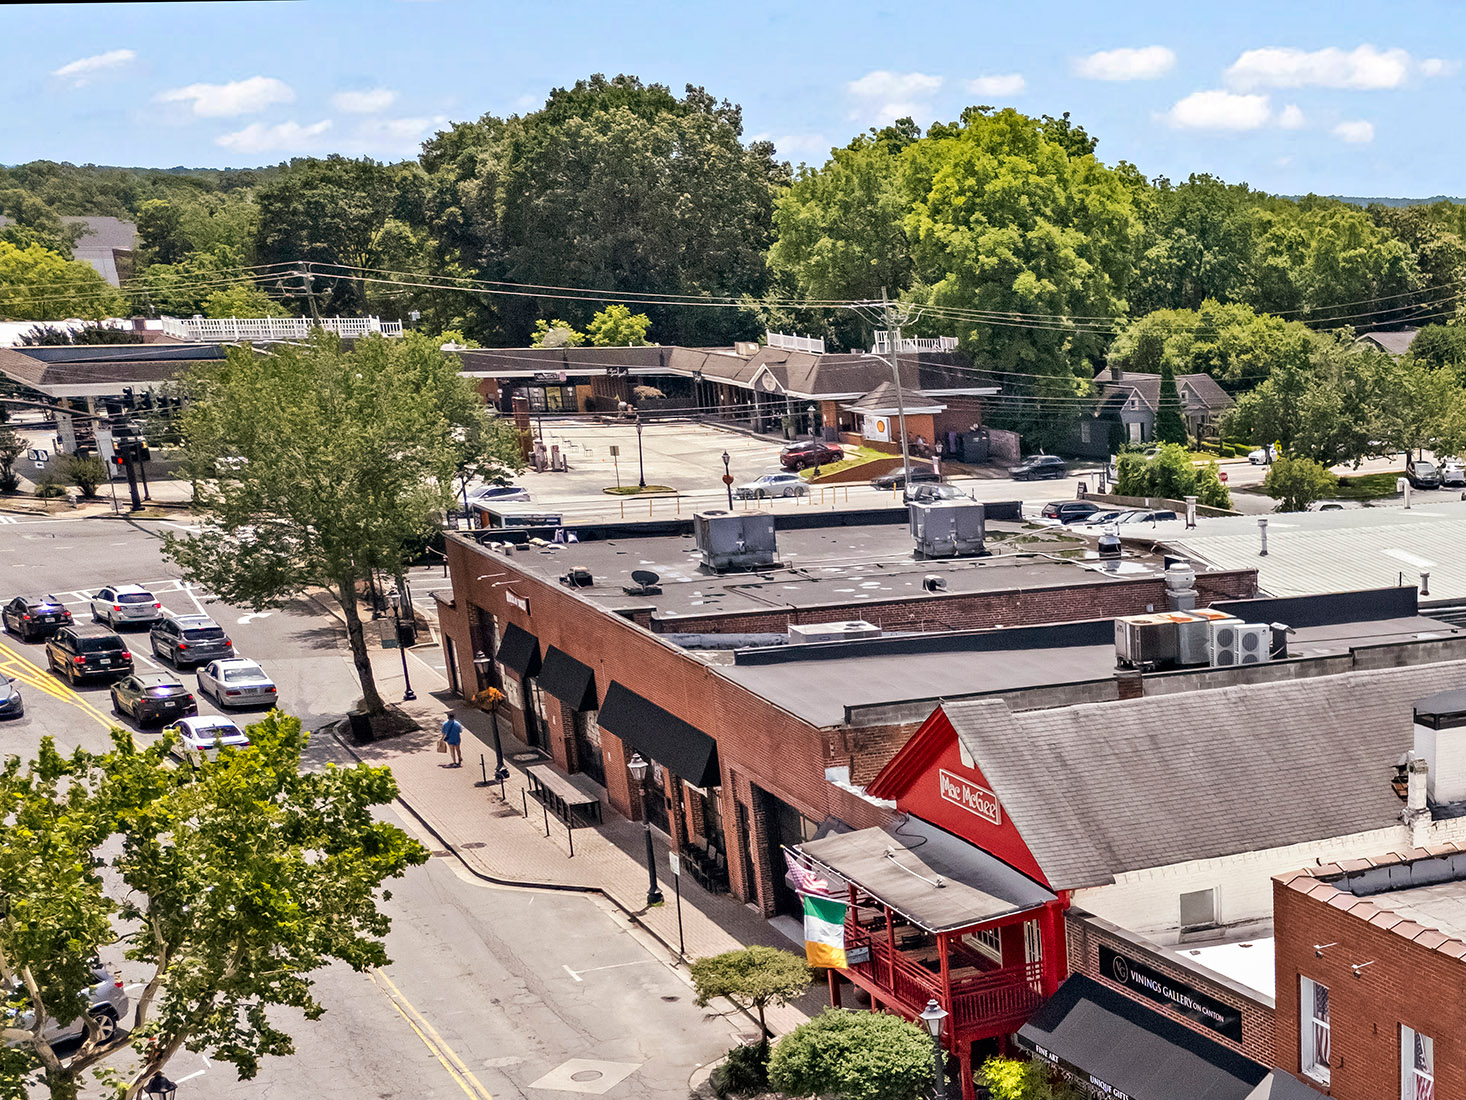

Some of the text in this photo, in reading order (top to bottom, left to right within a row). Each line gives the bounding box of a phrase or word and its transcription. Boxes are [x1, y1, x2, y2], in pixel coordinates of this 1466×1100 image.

[942, 775, 996, 818] Mac McGee
[1131, 970, 1224, 1023] VININGS GALLERY ON CANTON
[1035, 1044, 1059, 1063] FINE ART
[1089, 1075, 1112, 1093] UNIQUE
